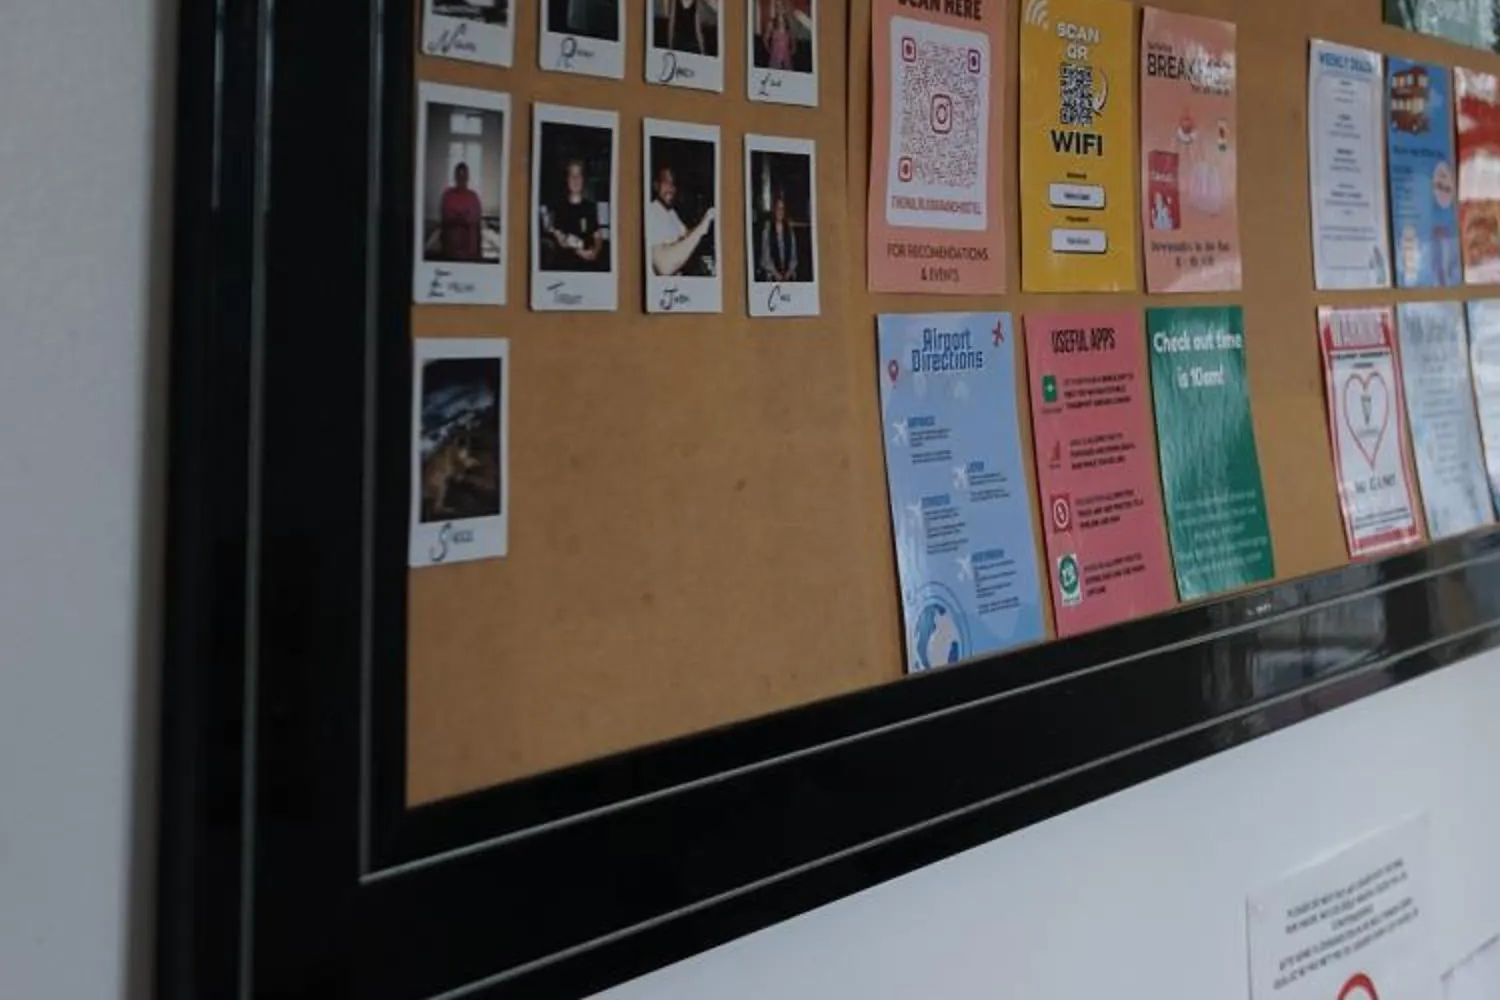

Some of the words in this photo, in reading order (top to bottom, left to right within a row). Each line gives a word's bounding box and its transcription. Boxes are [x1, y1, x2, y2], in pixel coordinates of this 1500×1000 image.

[1056, 22, 1102, 44] SCAN
[1067, 43, 1088, 61] QR
[1050, 129, 1104, 157] WIFI
[887, 243, 907, 258] FOR
[923, 328, 972, 353] Airport
[1051, 328, 1089, 355] USEFUL
[1090, 327, 1116, 351] APPS
[1153, 331, 1191, 353] Check
[1193, 334, 1214, 350] out
[1215, 330, 1243, 349] time
[911, 349, 984, 373] Directions
